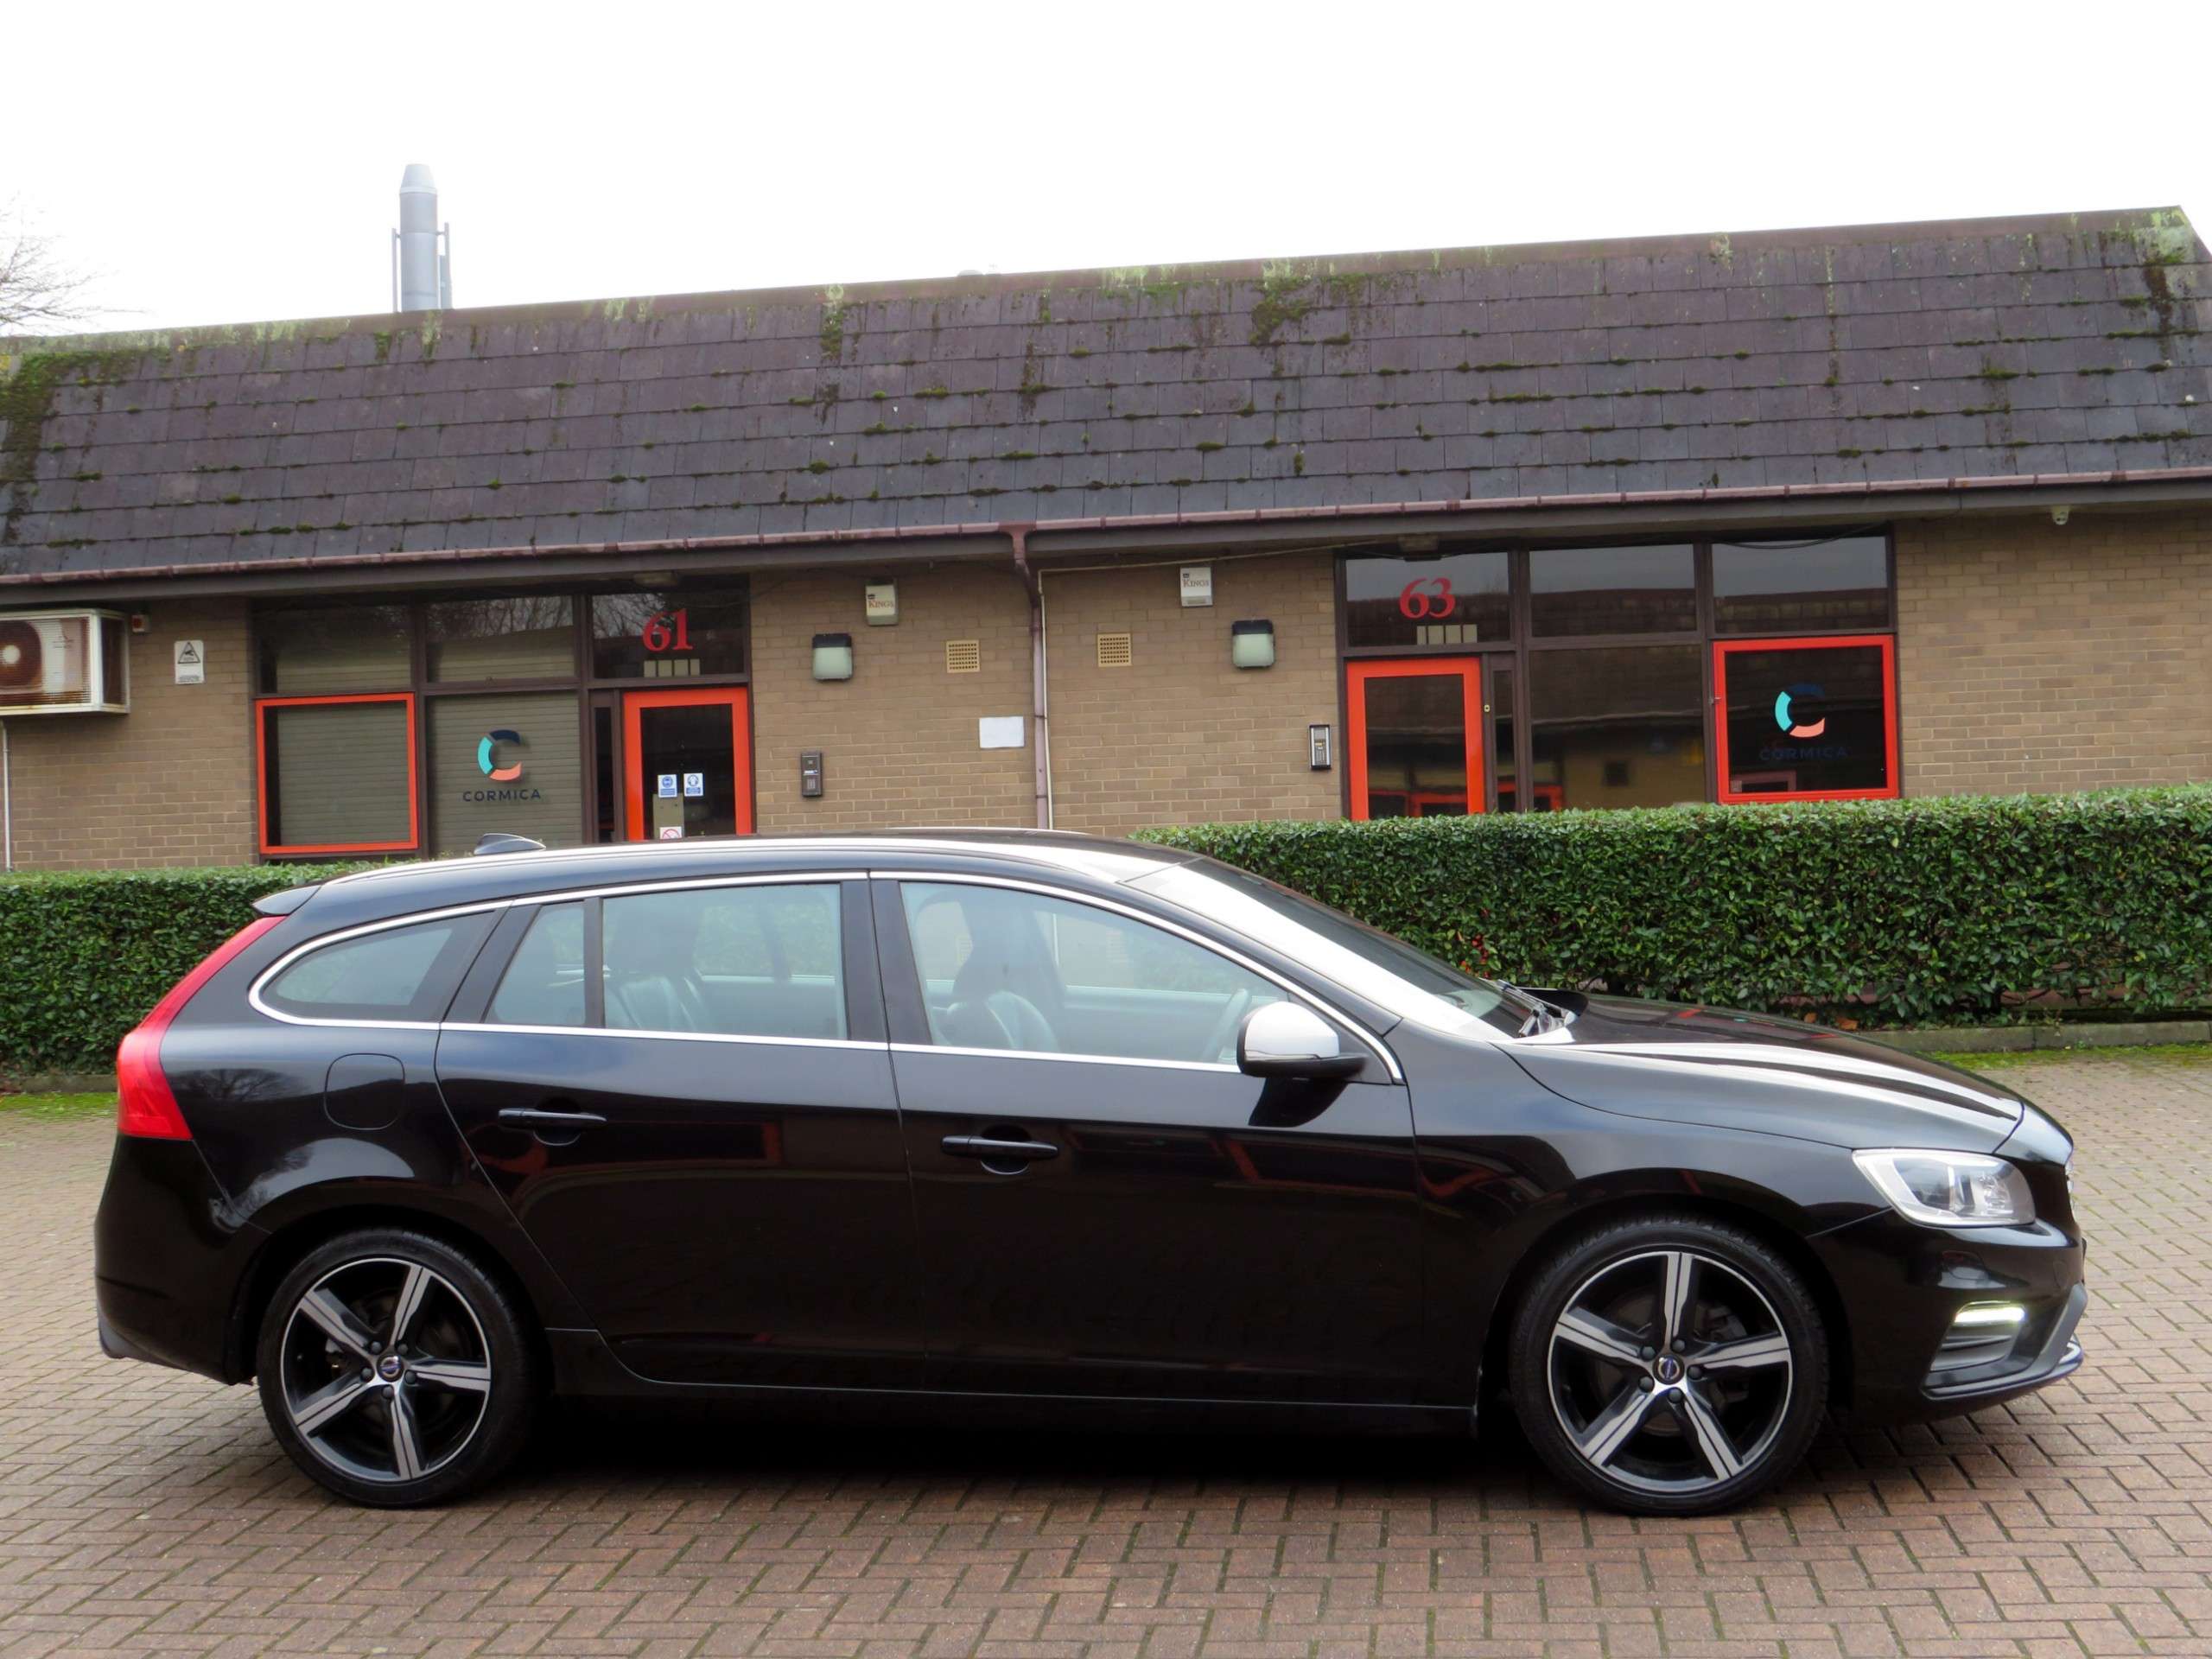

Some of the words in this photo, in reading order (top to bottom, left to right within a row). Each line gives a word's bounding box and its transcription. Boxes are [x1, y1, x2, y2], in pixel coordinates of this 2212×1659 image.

[1399, 576, 1456, 620] 63
[643, 608, 694, 652] 61
[462, 788, 541, 802] CORMICA
